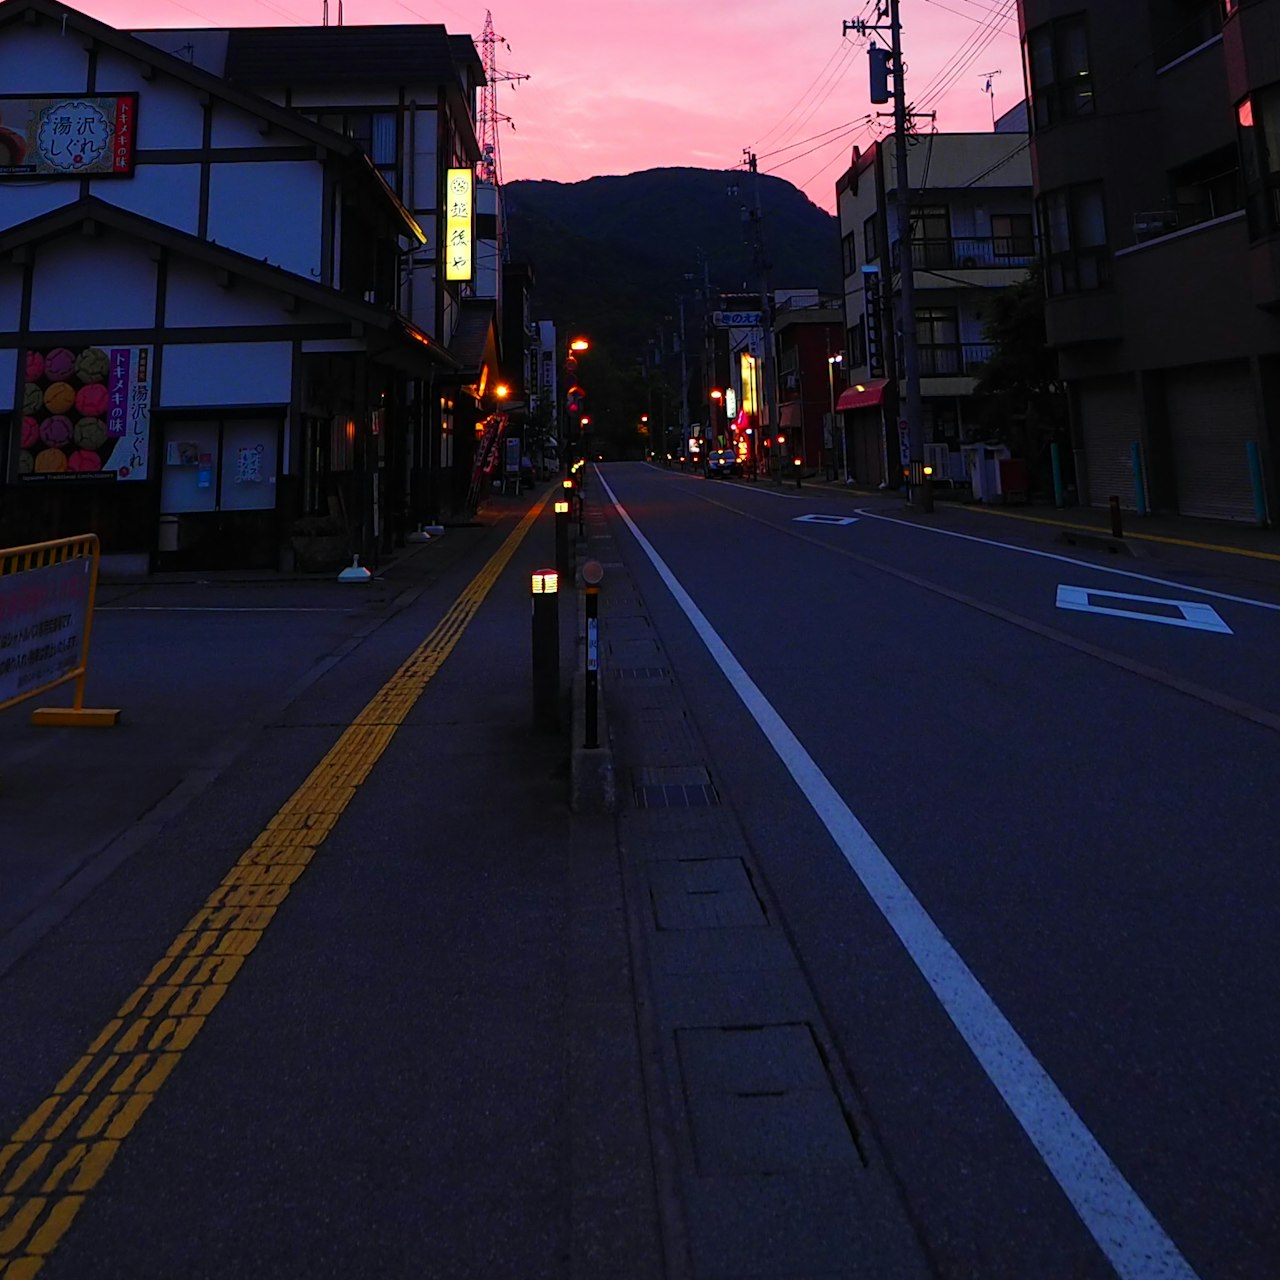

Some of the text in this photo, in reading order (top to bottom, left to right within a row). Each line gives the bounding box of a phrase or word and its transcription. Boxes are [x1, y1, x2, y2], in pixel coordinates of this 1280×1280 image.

[51, 138, 99, 156] しぐれ
[53, 117, 95, 135] 湯沢
[116, 103, 128, 168] トキメキの味
[451, 202, 468, 270] 越後や
[109, 352, 125, 433] トキメキの味
[130, 385, 148, 468] 湯沢しぐれ
